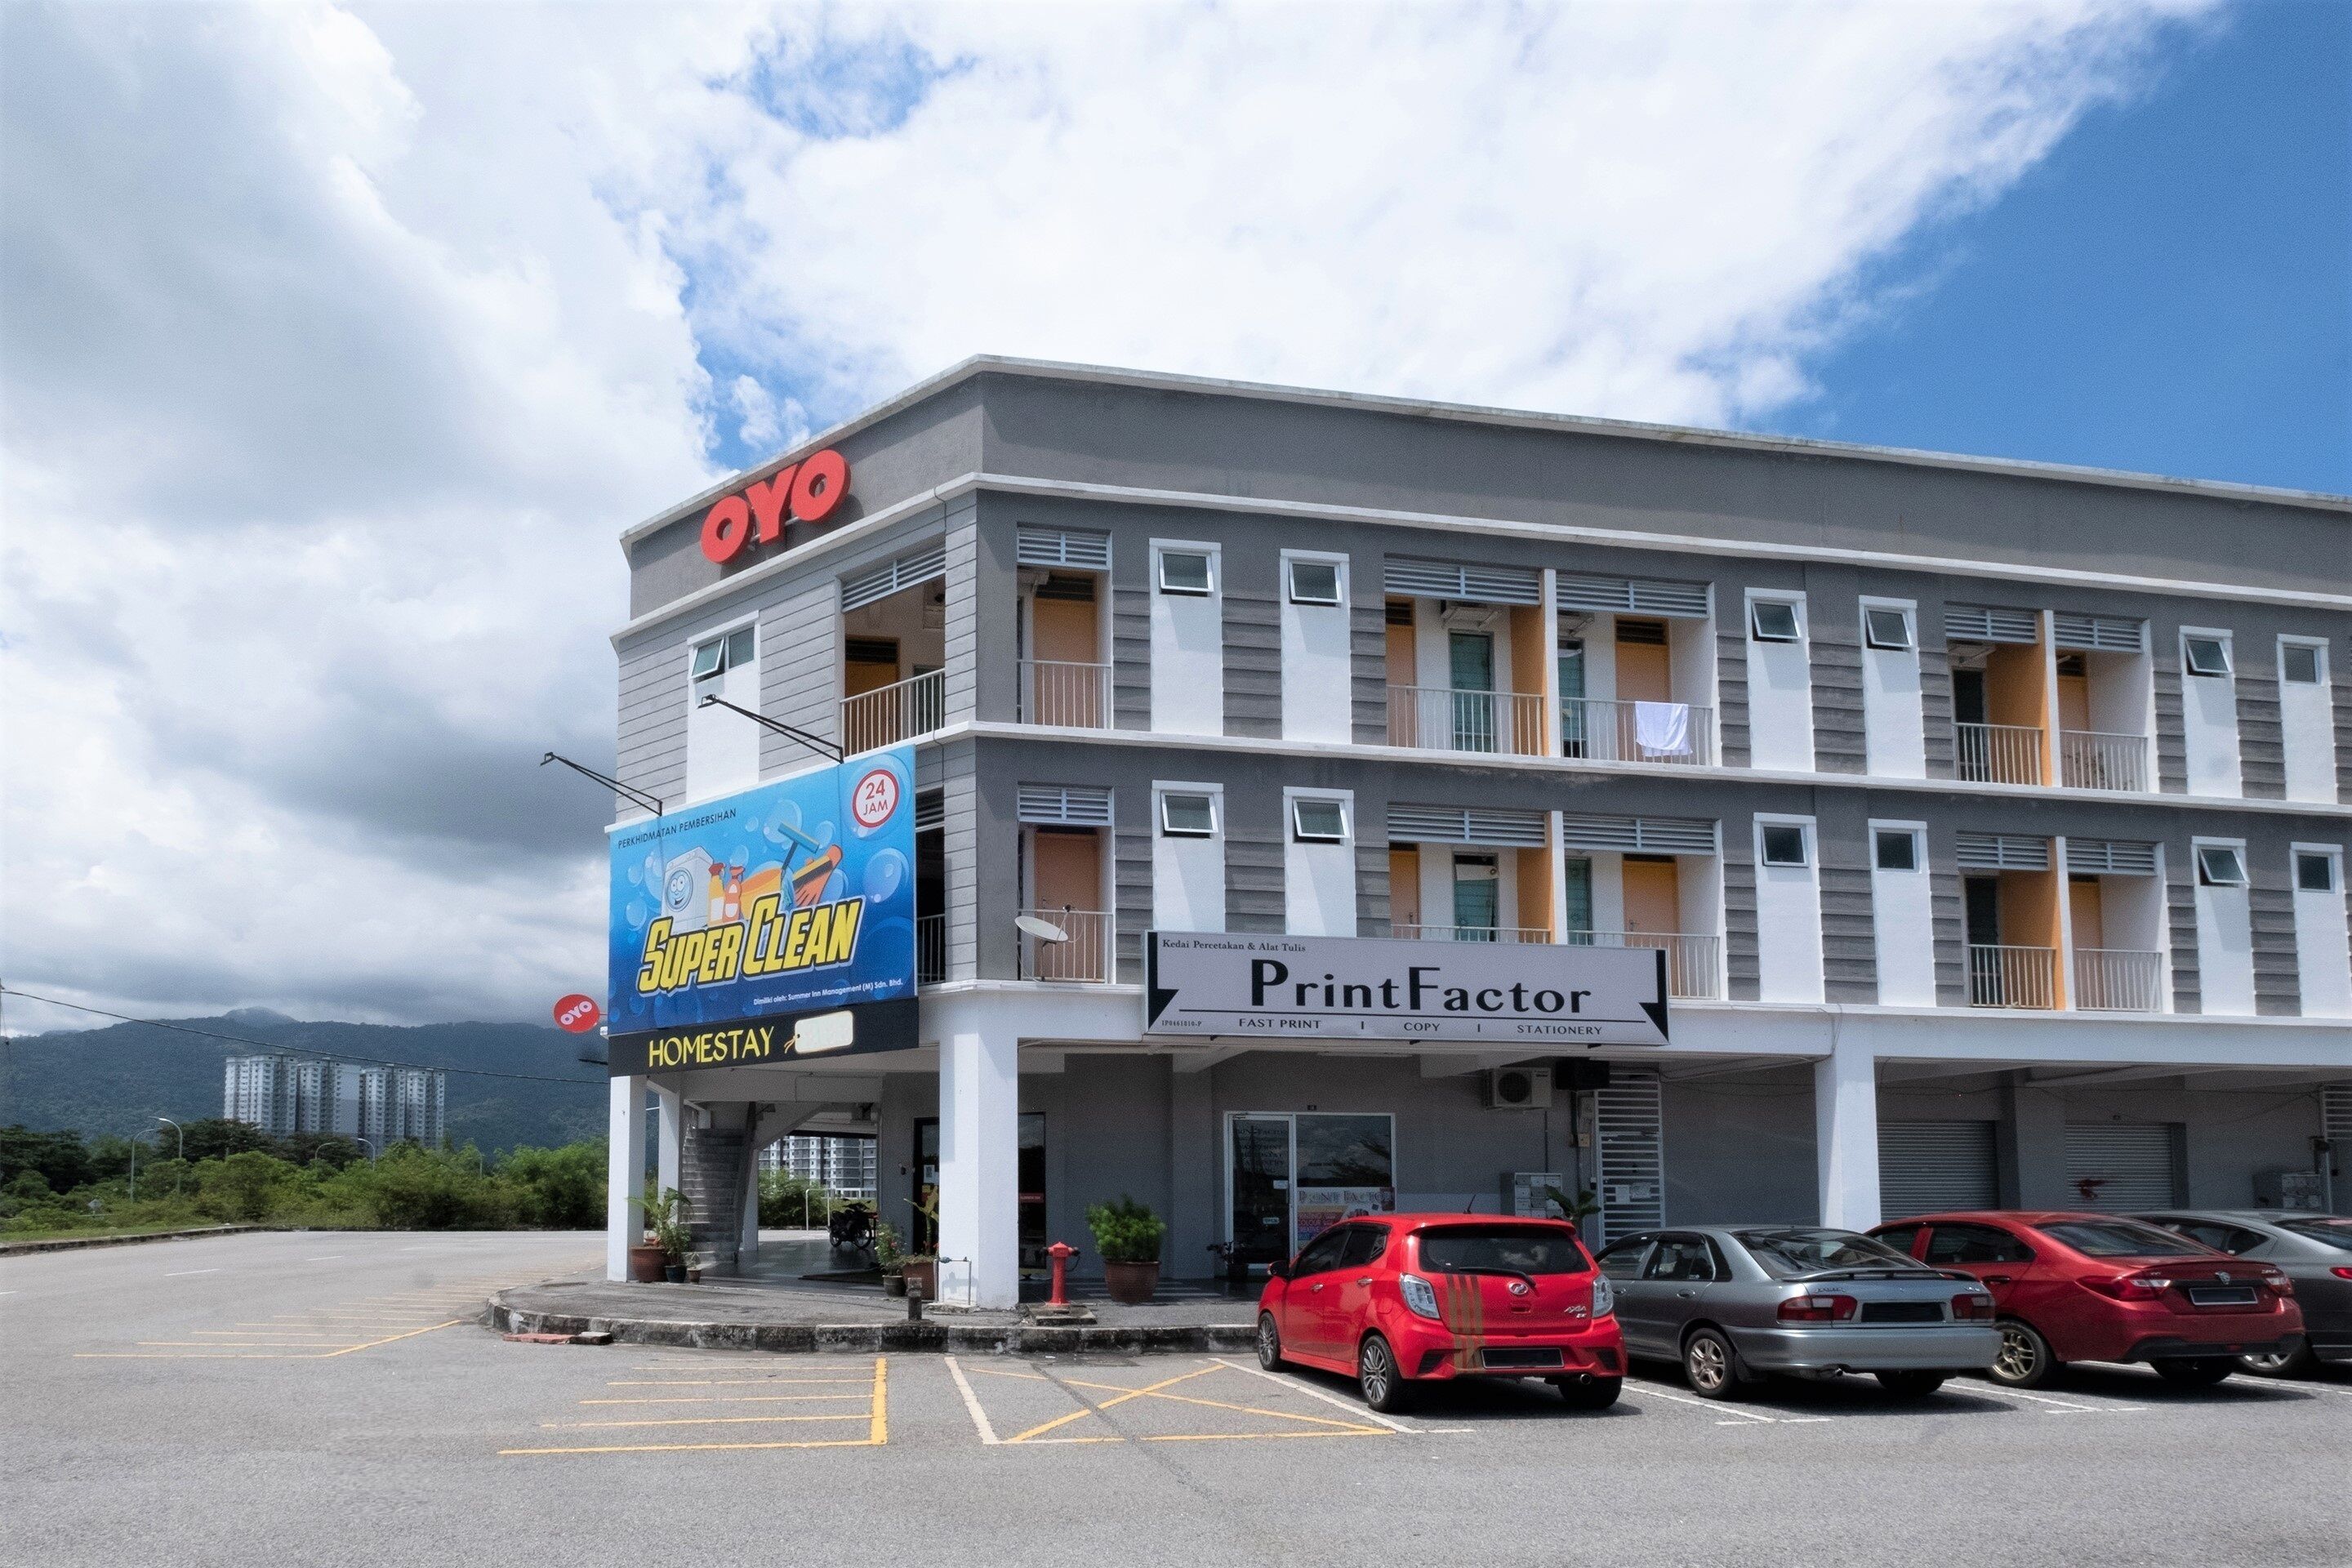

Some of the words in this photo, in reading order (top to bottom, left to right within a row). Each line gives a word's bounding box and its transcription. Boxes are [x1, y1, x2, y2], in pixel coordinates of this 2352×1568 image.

[701, 448, 849, 564] OYO
[866, 779, 885, 800] 24
[863, 800, 889, 815] JAM
[618, 825, 676, 849] PERKHIDMATAN
[679, 808, 737, 832] PEMBERSIHAN
[638, 916, 745, 993] SUPER
[742, 893, 863, 977] CLEAN
[1162, 939, 1189, 948] Kedai
[1193, 941, 1245, 950] Percetakan
[1247, 942, 1256, 951] &
[1258, 942, 1279, 951] Alat
[1281, 943, 1306, 952] Tulis
[788, 991, 811, 1001] Summer
[822, 985, 862, 999] Management
[862, 982, 874, 991] (M)
[874, 981, 889, 989] Sdn.
[1251, 959, 1592, 1013] PrintFactor
[560, 1001, 592, 1024] OYO
[1239, 1018, 1272, 1028] FAST
[1280, 1019, 1321, 1029] PRINT
[1403, 1022, 1441, 1031] COPY
[1517, 1024, 1602, 1035] STATIONERY
[648, 1026, 774, 1067] HOMESTAY
